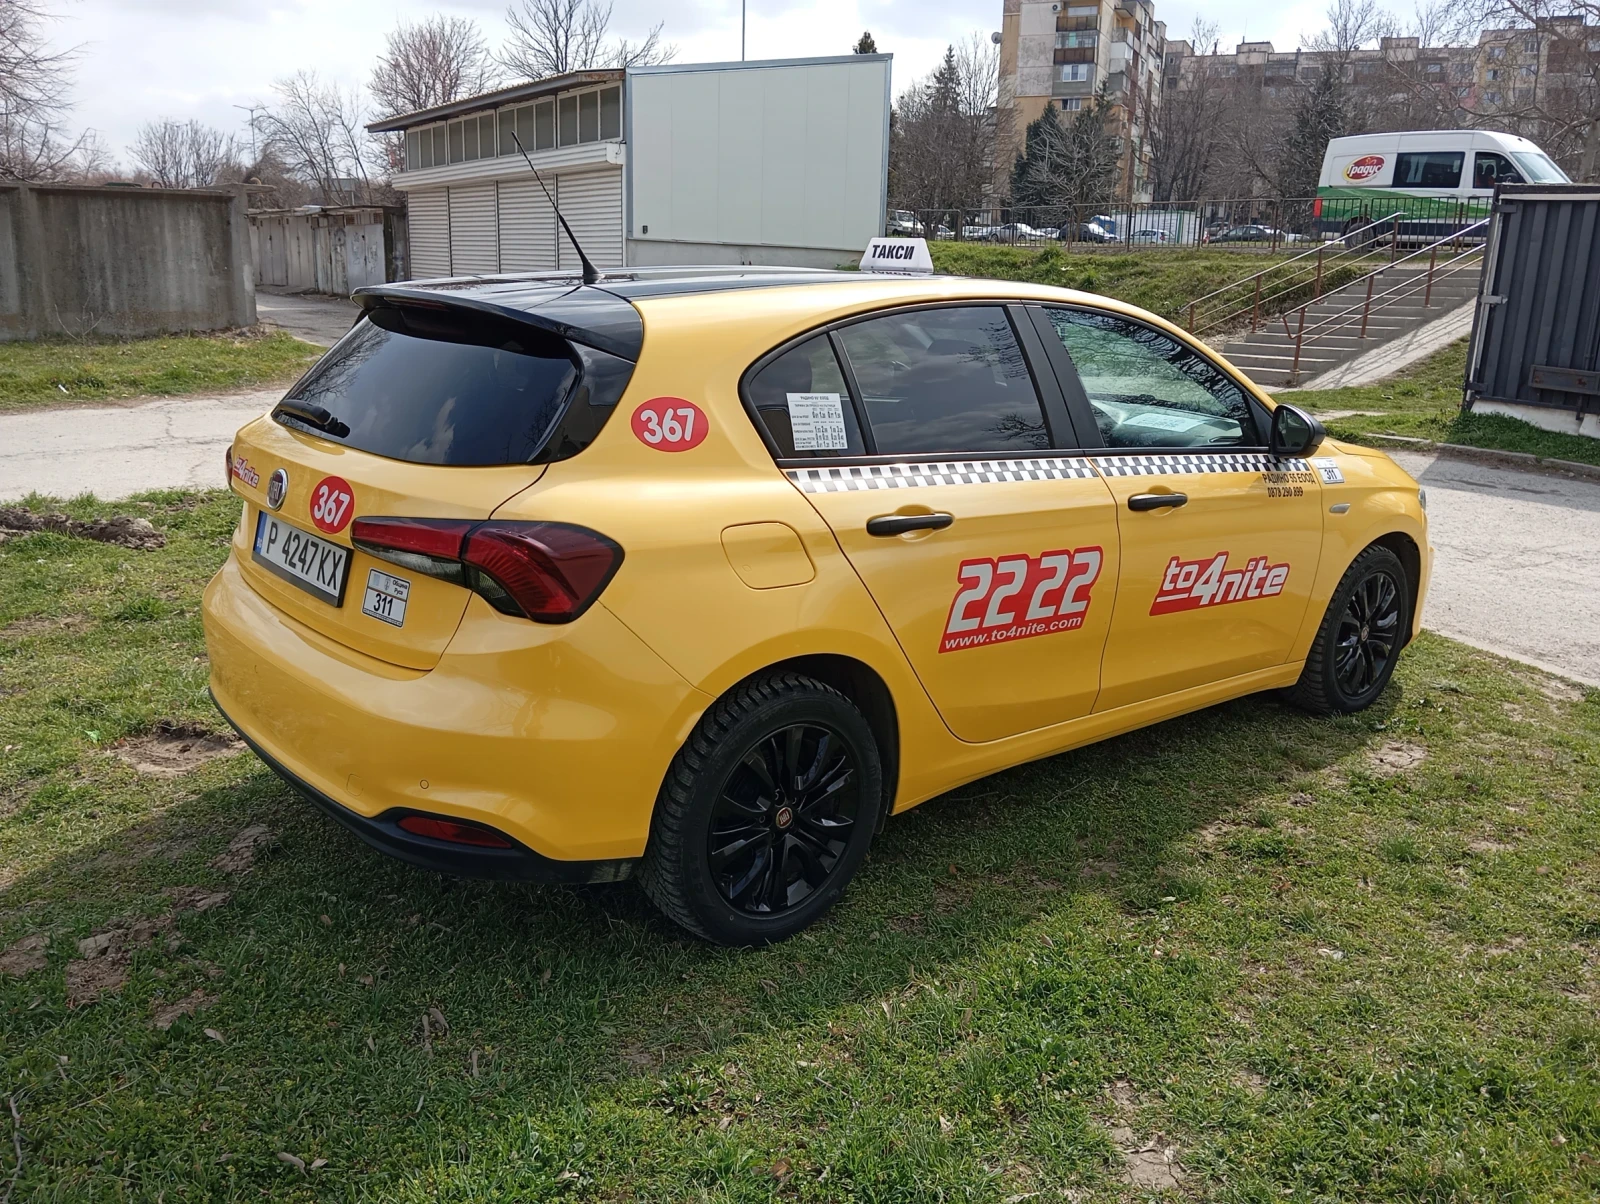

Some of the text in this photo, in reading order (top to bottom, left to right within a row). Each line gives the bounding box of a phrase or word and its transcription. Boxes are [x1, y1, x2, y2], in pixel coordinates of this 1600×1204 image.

[1347, 164, 1383, 177] Градус
[871, 244, 916, 260] ТАКСИ
[640, 408, 695, 444] 367
[1262, 473, 1317, 485] РАДИНО 55 ЕООД
[1324, 469, 1338, 480] 311
[1267, 486, 1304, 498] 0878 290 899
[313, 484, 351, 527] 367
[1161, 555, 1290, 605] to4nite
[373, 592, 393, 617] 311
[945, 616, 1082, 649] www.to4nite.com
